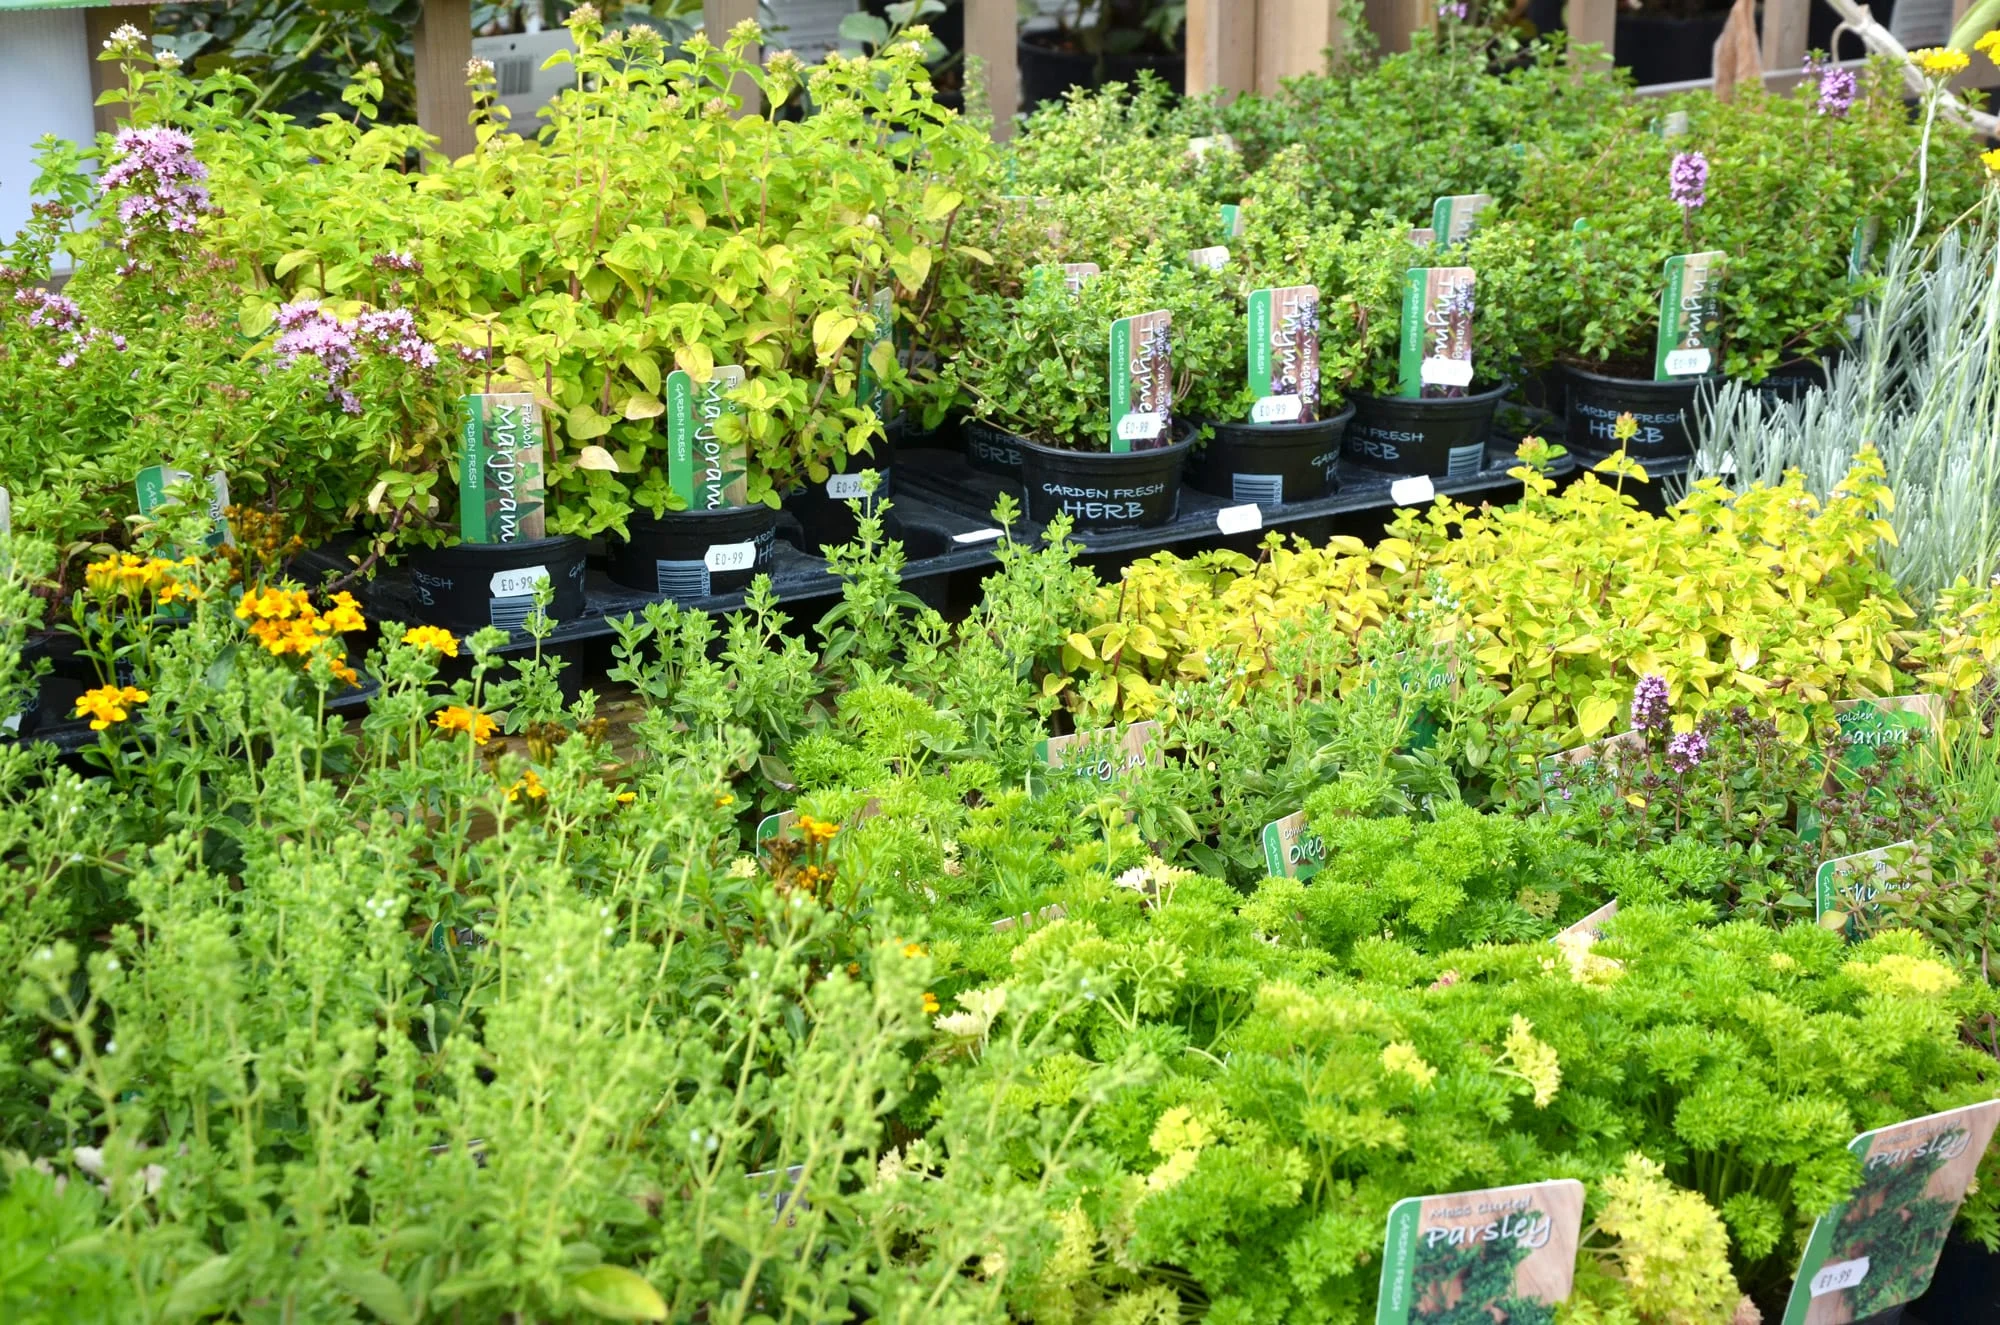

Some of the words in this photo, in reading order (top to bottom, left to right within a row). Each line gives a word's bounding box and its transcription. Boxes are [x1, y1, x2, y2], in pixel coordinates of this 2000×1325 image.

[1271, 296, 1301, 386] Thyme
[1130, 320, 1155, 413] Thyme
[675, 383, 684, 426] GARDEN
[522, 403, 533, 449] French
[1370, 427, 1424, 444] FRESH
[677, 427, 686, 461] FRESH
[1352, 437, 1400, 460] ERB
[468, 454, 477, 489] FRESH
[487, 404, 525, 543] Marjoram
[1042, 483, 1109, 499] GARDEN
[1114, 483, 1165, 499] FRESH
[1064, 500, 1144, 520] HERB
[1289, 836, 1327, 864] Oreg
[1869, 1131, 1971, 1171] Parsley
[1426, 1215, 1552, 1249] Parsley
